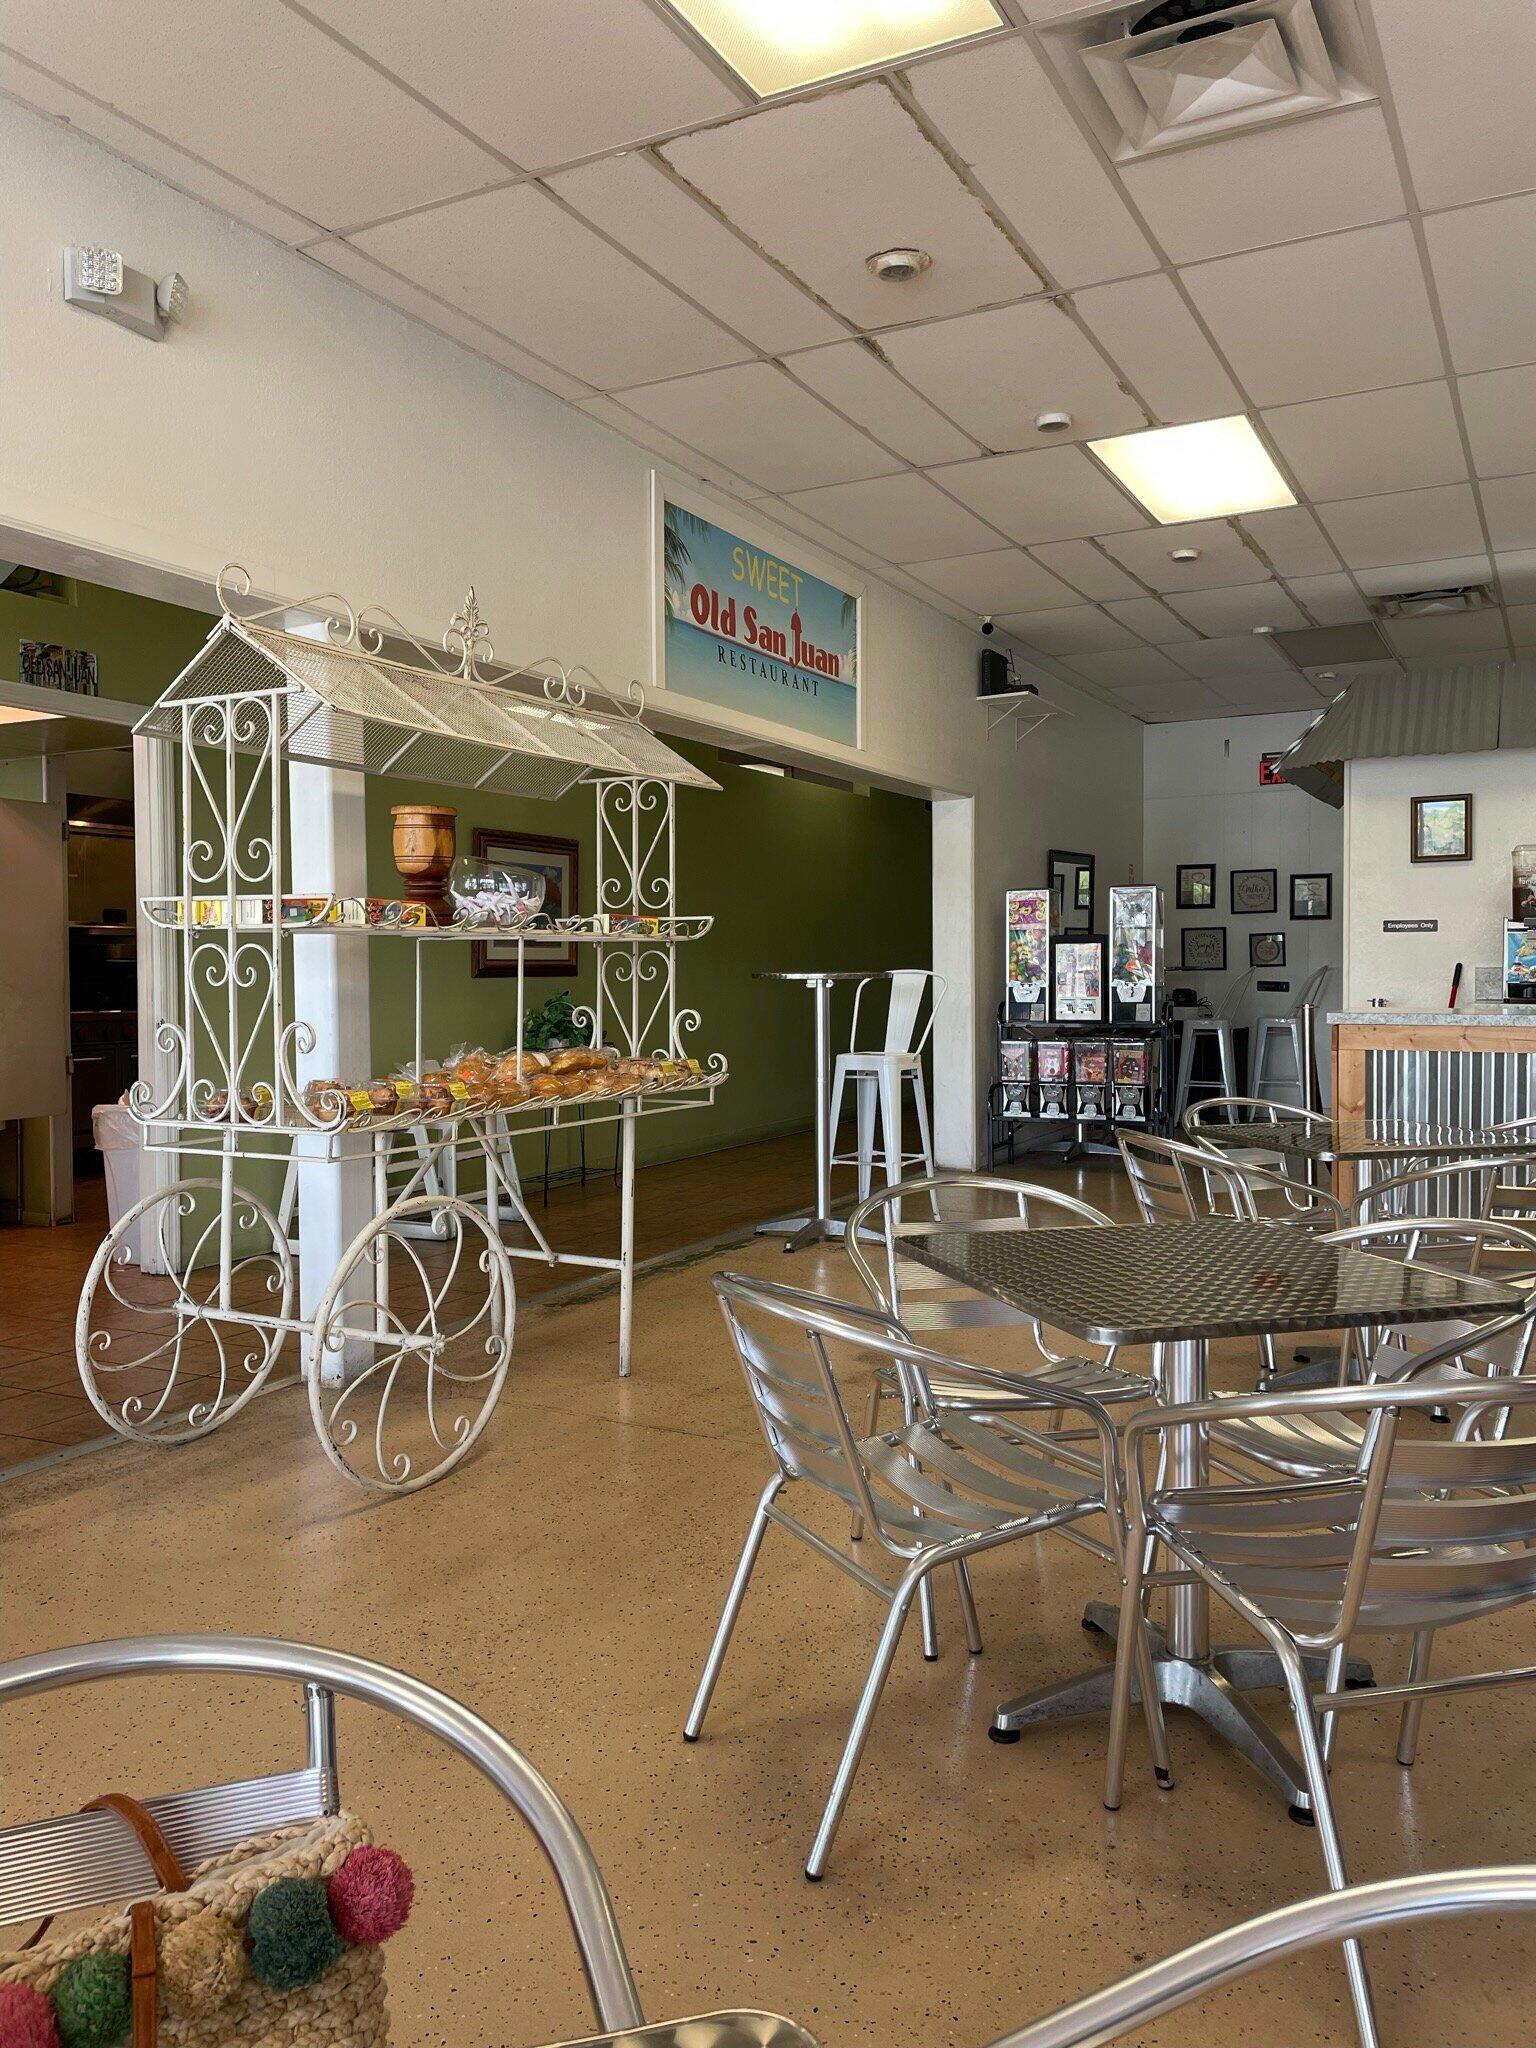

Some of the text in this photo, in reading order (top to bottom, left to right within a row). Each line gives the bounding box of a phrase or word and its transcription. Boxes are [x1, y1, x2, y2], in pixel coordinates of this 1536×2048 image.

[731, 546, 803, 606] SWEET
[690, 583, 840, 678] Old San Juan
[717, 644, 819, 697] RESTAURANT
